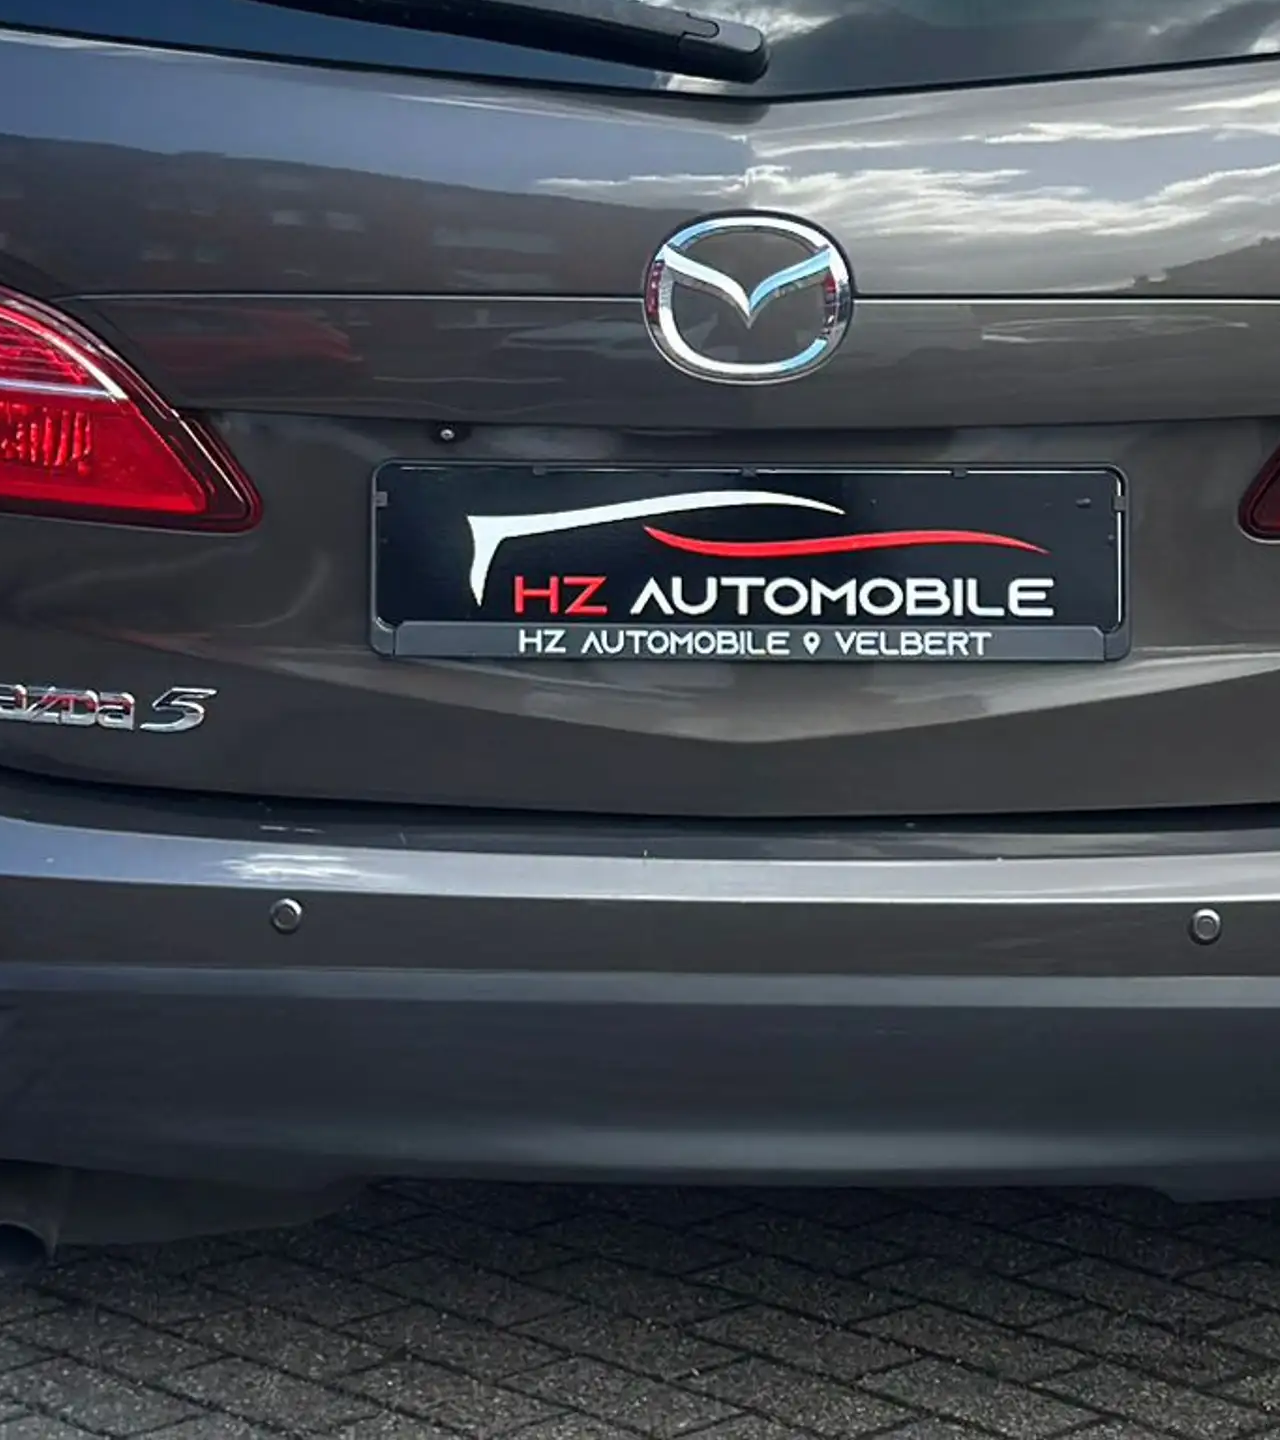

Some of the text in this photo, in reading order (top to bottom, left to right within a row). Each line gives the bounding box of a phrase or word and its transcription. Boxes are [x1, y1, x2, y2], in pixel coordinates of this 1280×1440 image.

[512, 575, 1055, 618] HZ AUTOMOBILE
[519, 630, 993, 658] HZ AUTOMOBILE VELBERT
